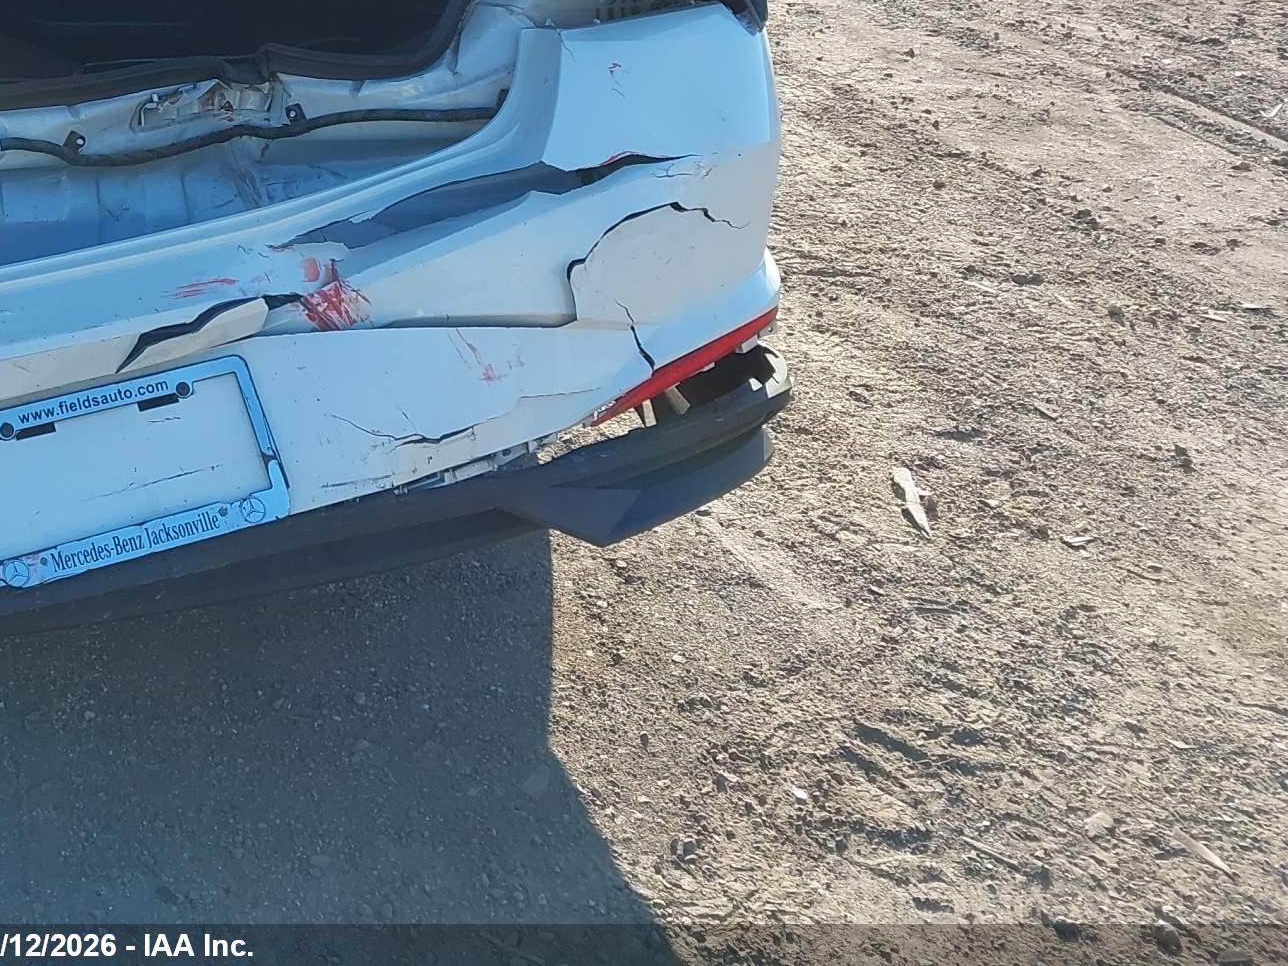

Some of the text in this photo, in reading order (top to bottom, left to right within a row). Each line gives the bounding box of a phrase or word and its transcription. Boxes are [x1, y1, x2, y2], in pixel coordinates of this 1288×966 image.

[18, 380, 169, 424] www.fieldsauto.com
[50, 513, 221, 573] Mercedes-Benz Jacksonville
